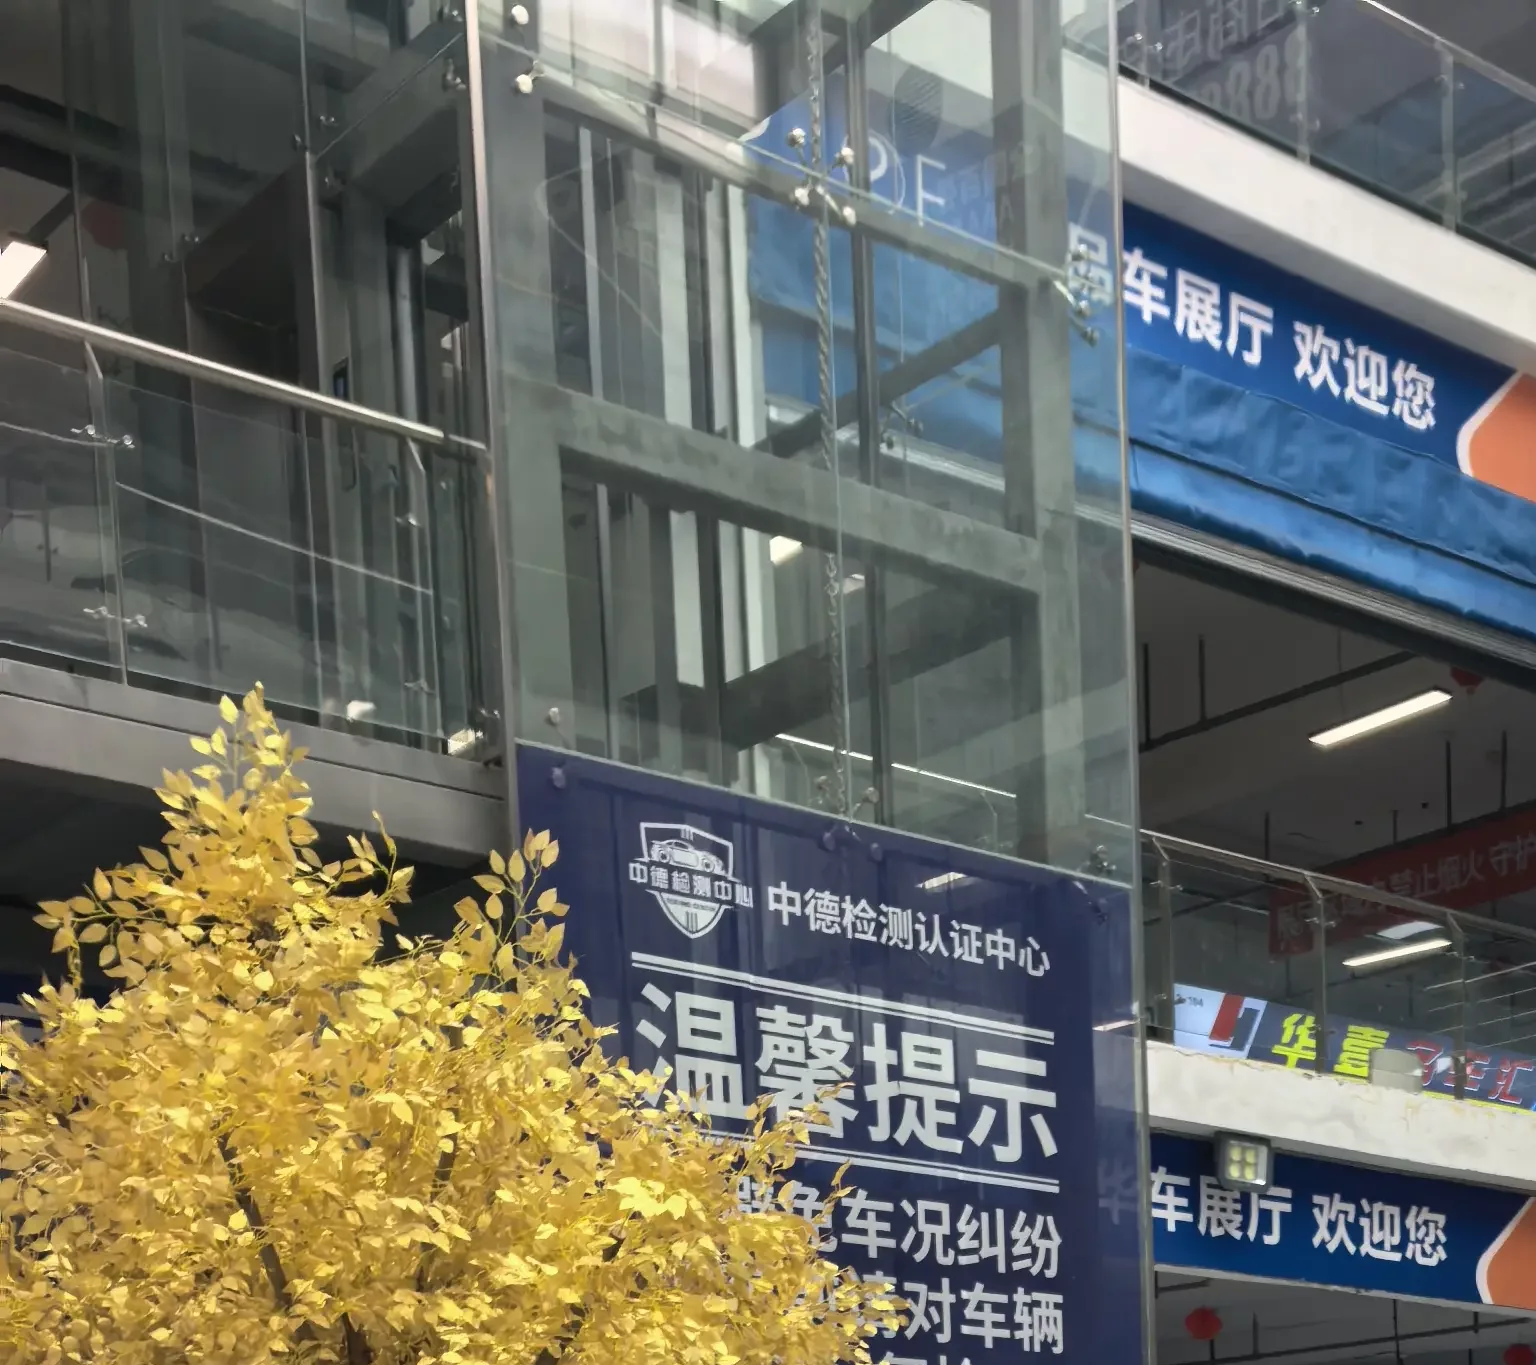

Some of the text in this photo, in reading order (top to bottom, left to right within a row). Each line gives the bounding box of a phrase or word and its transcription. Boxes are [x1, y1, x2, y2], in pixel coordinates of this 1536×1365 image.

[1292, 320, 1437, 431] 欢迎您
[628, 861, 754, 908] 中德检测中心
[768, 881, 1051, 978] 中德检测认证中心
[636, 982, 1059, 1163] 温馨提示
[1312, 1193, 1448, 1267] 欢迎您
